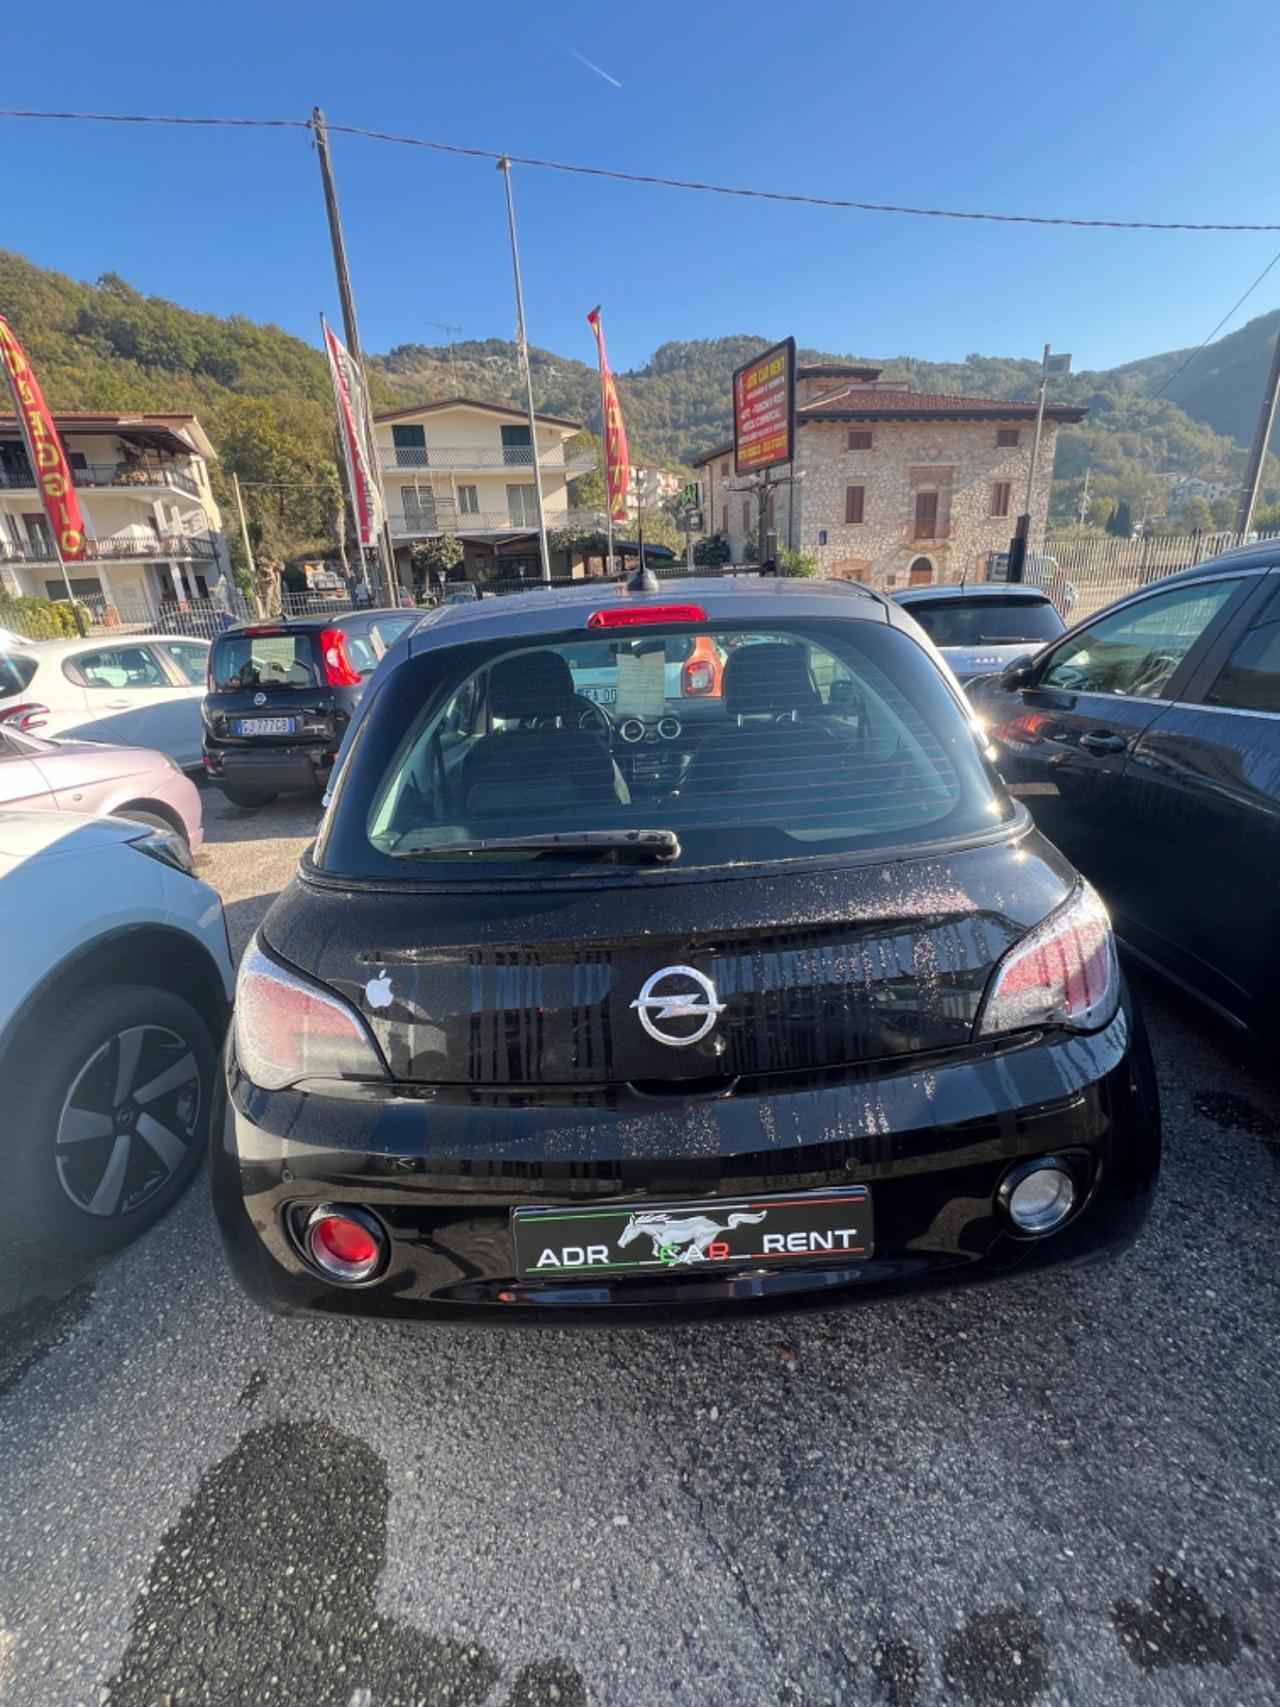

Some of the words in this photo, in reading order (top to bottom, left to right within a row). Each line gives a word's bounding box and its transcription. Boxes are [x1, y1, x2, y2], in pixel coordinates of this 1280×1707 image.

[536, 1244, 610, 1268] ADR
[659, 1242, 730, 1265] CAR
[763, 1229, 857, 1254] RENT
